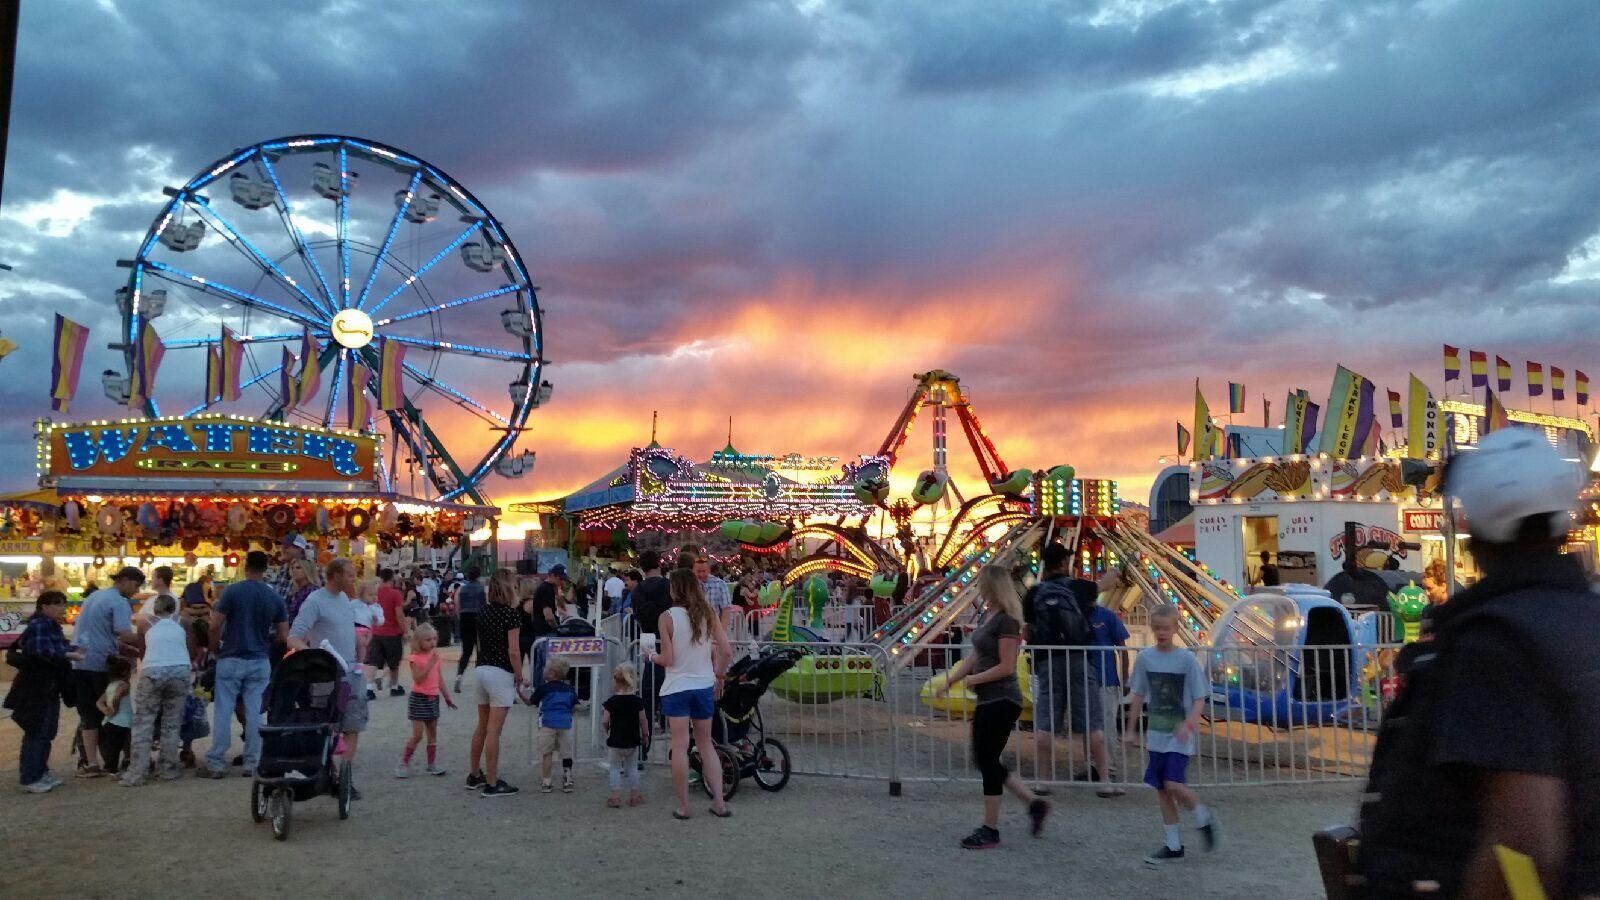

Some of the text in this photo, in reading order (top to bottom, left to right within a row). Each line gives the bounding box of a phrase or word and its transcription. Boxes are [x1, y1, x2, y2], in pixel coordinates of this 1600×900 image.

[63, 424, 362, 476] WATER
[1339, 425, 1350, 455] LEGS
[157, 460, 282, 470] RACE
[1409, 513, 1432, 528] CORN
[1329, 527, 1366, 560] TO
[550, 640, 603, 652] ENTER
